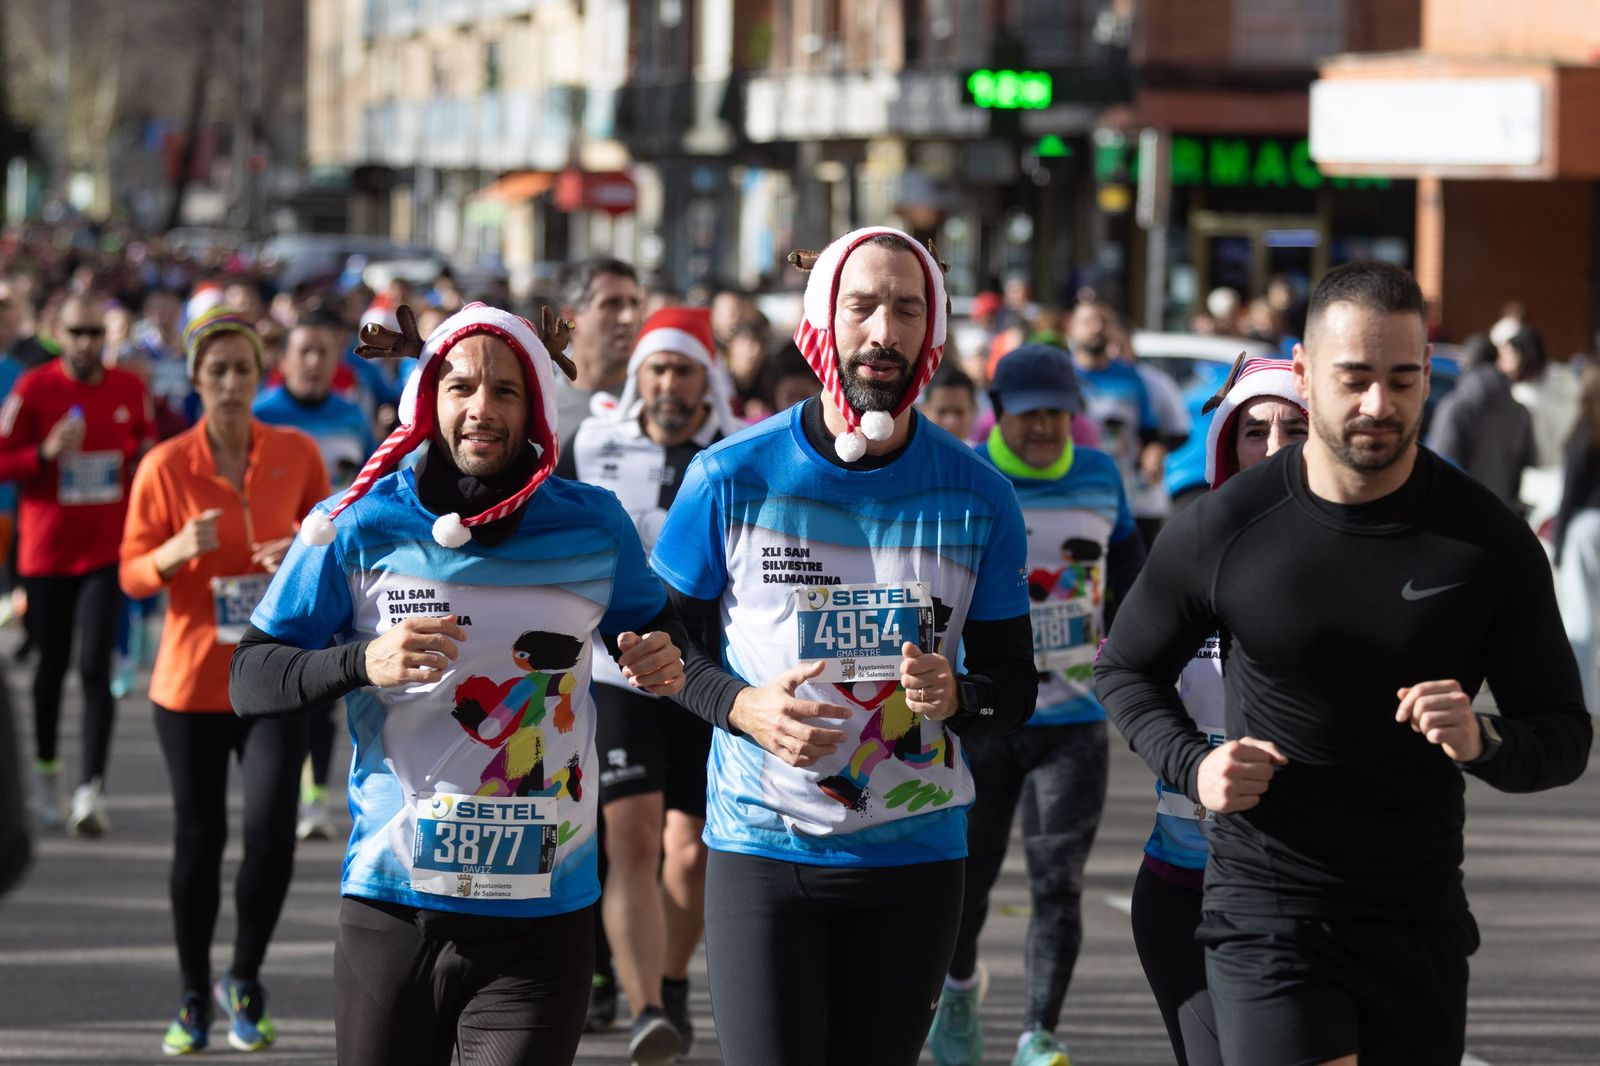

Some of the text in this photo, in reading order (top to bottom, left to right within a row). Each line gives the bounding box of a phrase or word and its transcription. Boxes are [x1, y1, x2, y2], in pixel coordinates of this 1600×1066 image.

[762, 547, 810, 558] XLI SAN
[762, 560, 822, 572] SILVESTRE
[762, 573, 841, 586] SALMANTINA
[387, 589, 435, 601] XLI SAN
[832, 588, 920, 606] SETEL
[389, 602, 450, 614] SILVESTRE
[814, 609, 903, 650] 4954
[836, 648, 881, 658] GMAESTRE
[857, 664, 895, 672] Ayuntamiento
[456, 801, 545, 820] SETEL
[433, 822, 525, 866] 3877
[462, 864, 492, 874] DAVIZ
[482, 889, 511, 897] Salamanca
